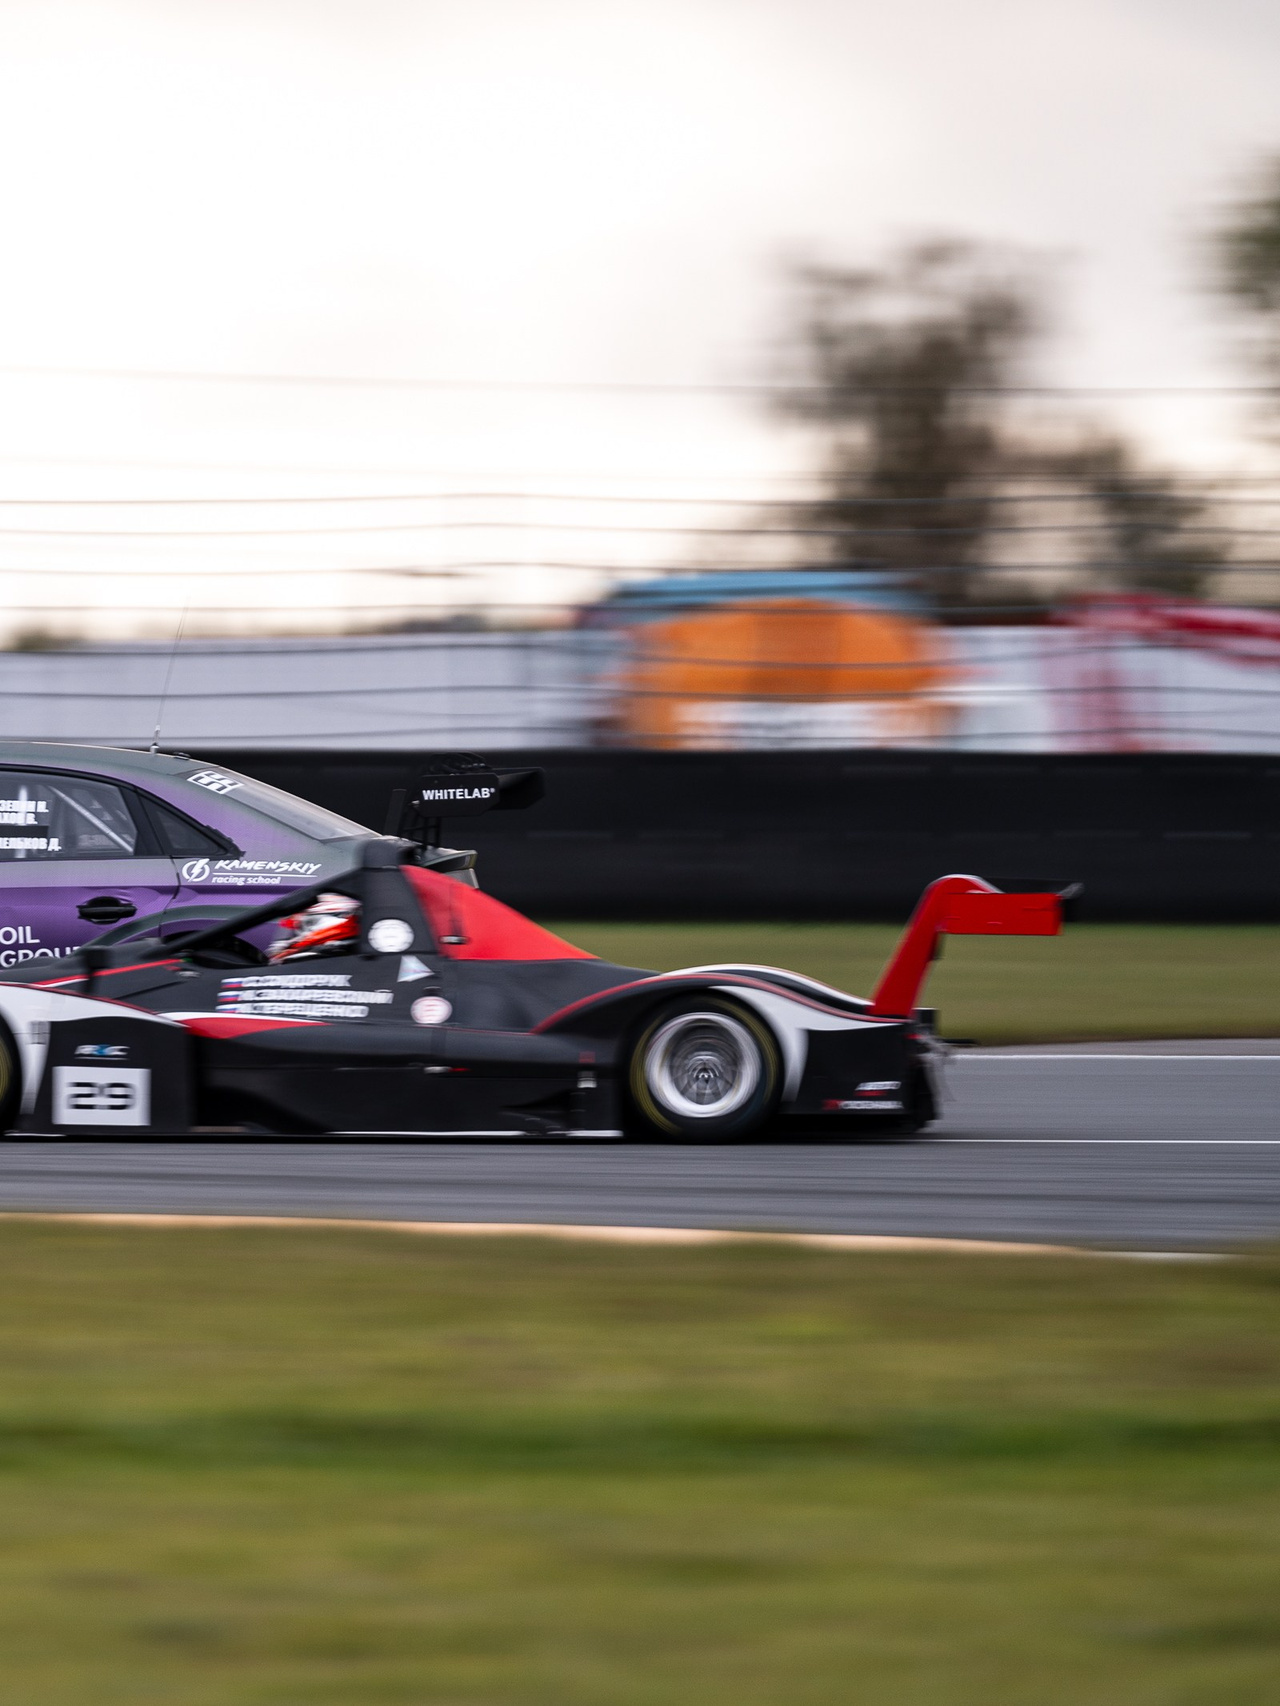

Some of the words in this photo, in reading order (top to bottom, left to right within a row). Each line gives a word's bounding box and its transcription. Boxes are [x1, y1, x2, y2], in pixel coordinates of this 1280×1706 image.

[214, 859, 322, 875] KAMENSKIY
[212, 876, 245, 886] racing
[246, 875, 281, 885] school
[0, 946, 81, 968] GROU
